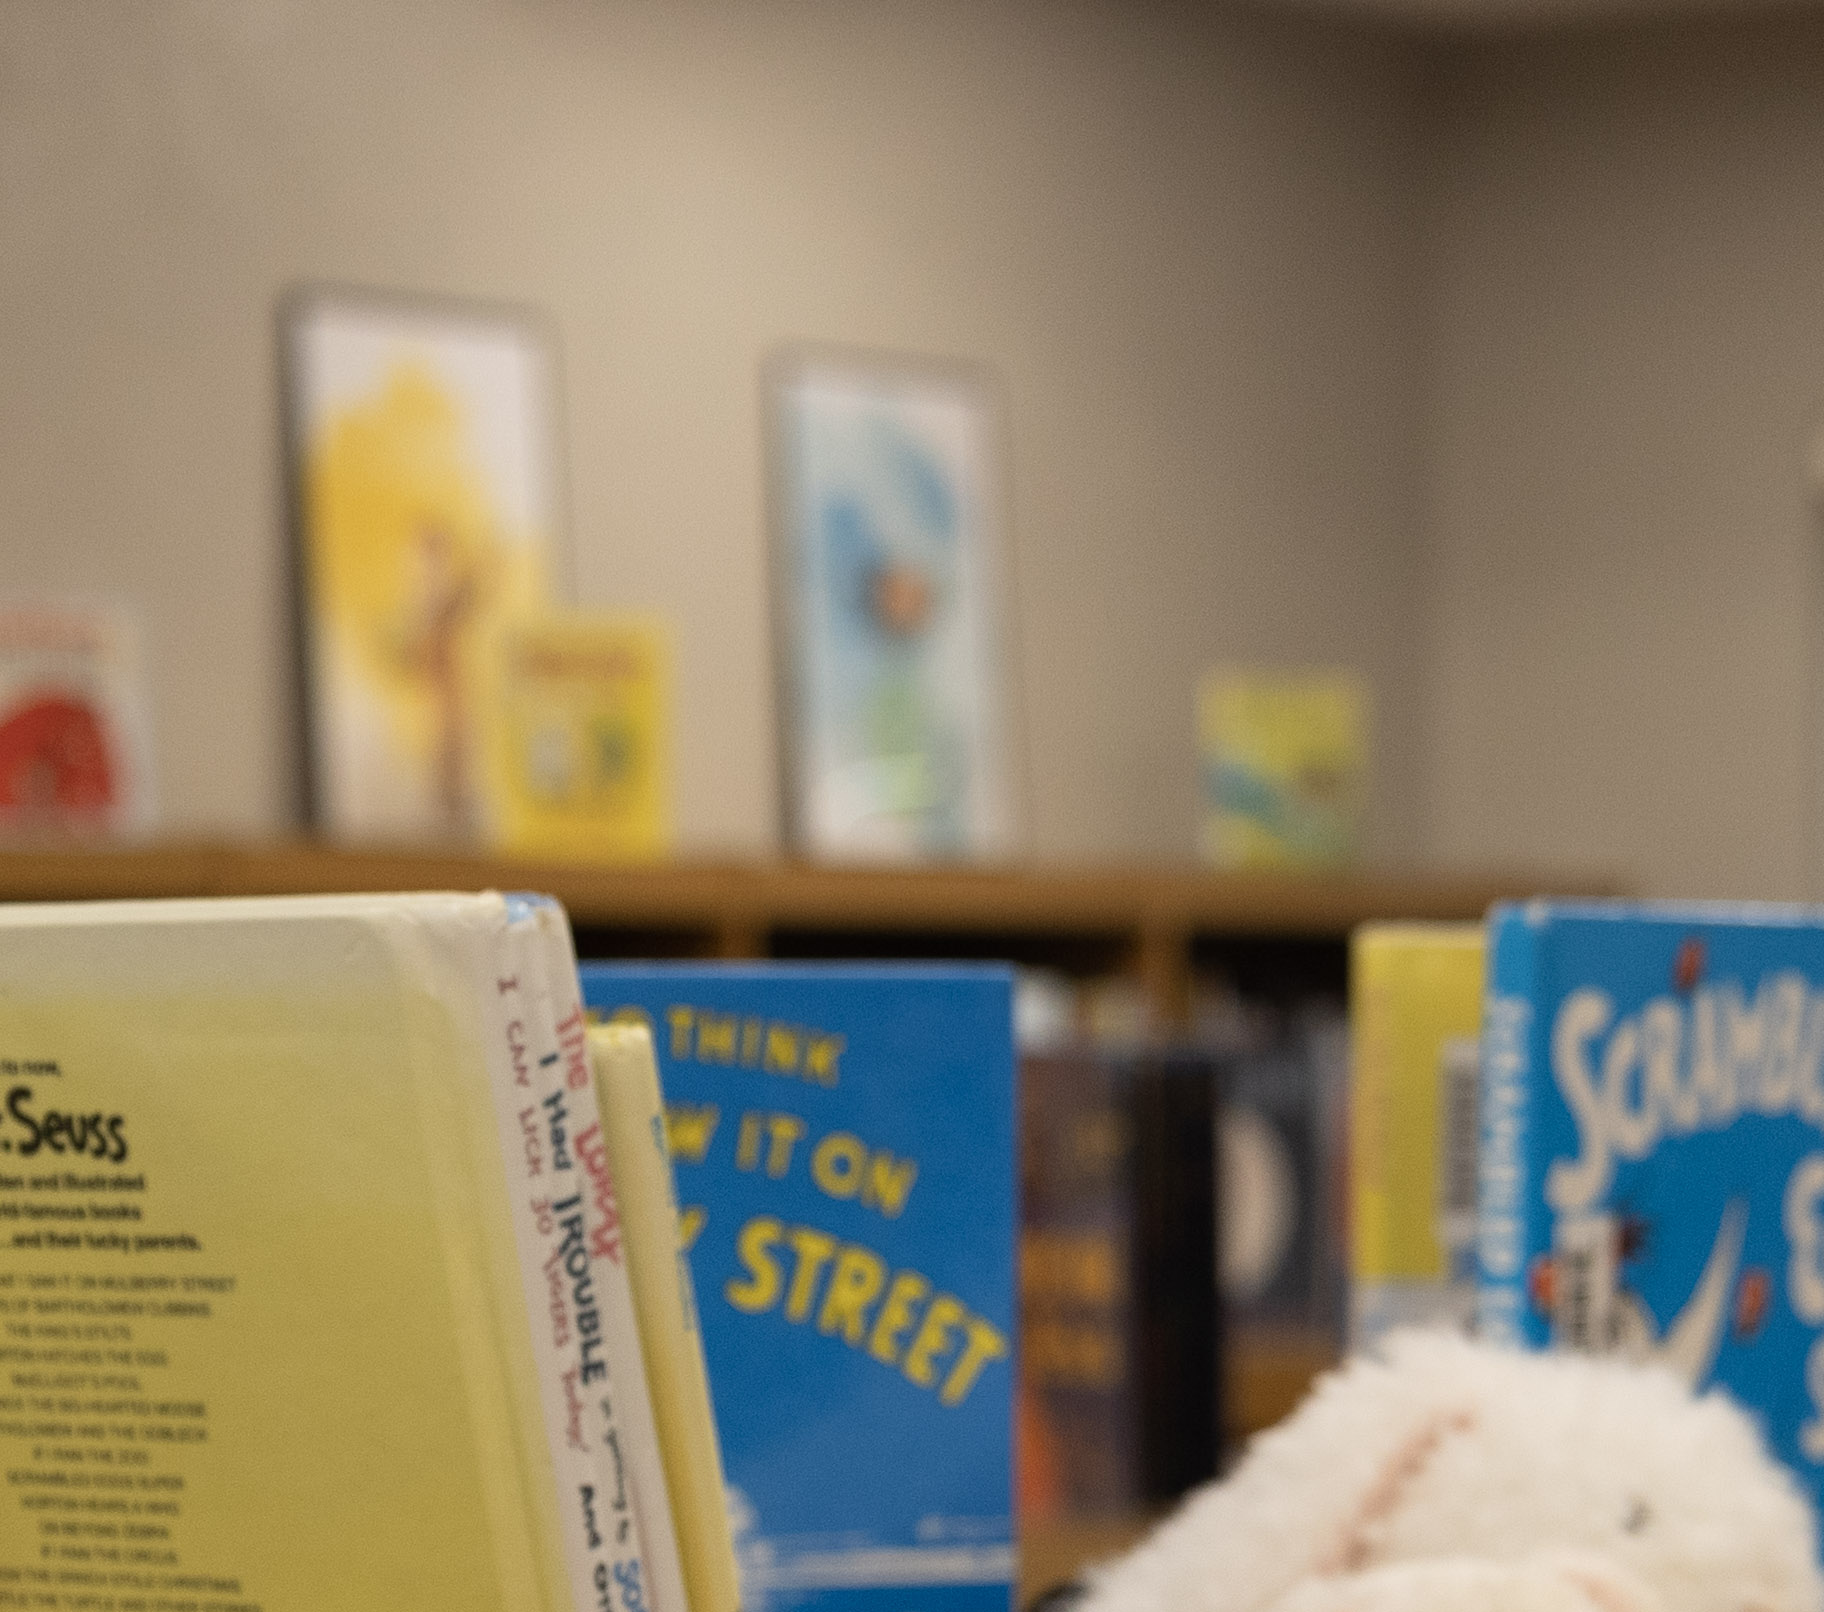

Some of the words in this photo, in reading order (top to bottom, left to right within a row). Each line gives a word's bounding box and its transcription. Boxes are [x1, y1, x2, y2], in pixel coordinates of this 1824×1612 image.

[505, 1018, 531, 1090] CAN
[667, 1005, 849, 1089] THINK
[5, 1084, 129, 1164] Seuss
[516, 1105, 543, 1179] LICK
[541, 1088, 573, 1172] Had
[735, 1110, 808, 1180] IT
[809, 1131, 920, 1221] ON
[551, 1191, 608, 1386] TROUBLE
[722, 1213, 1011, 1409] STREET
